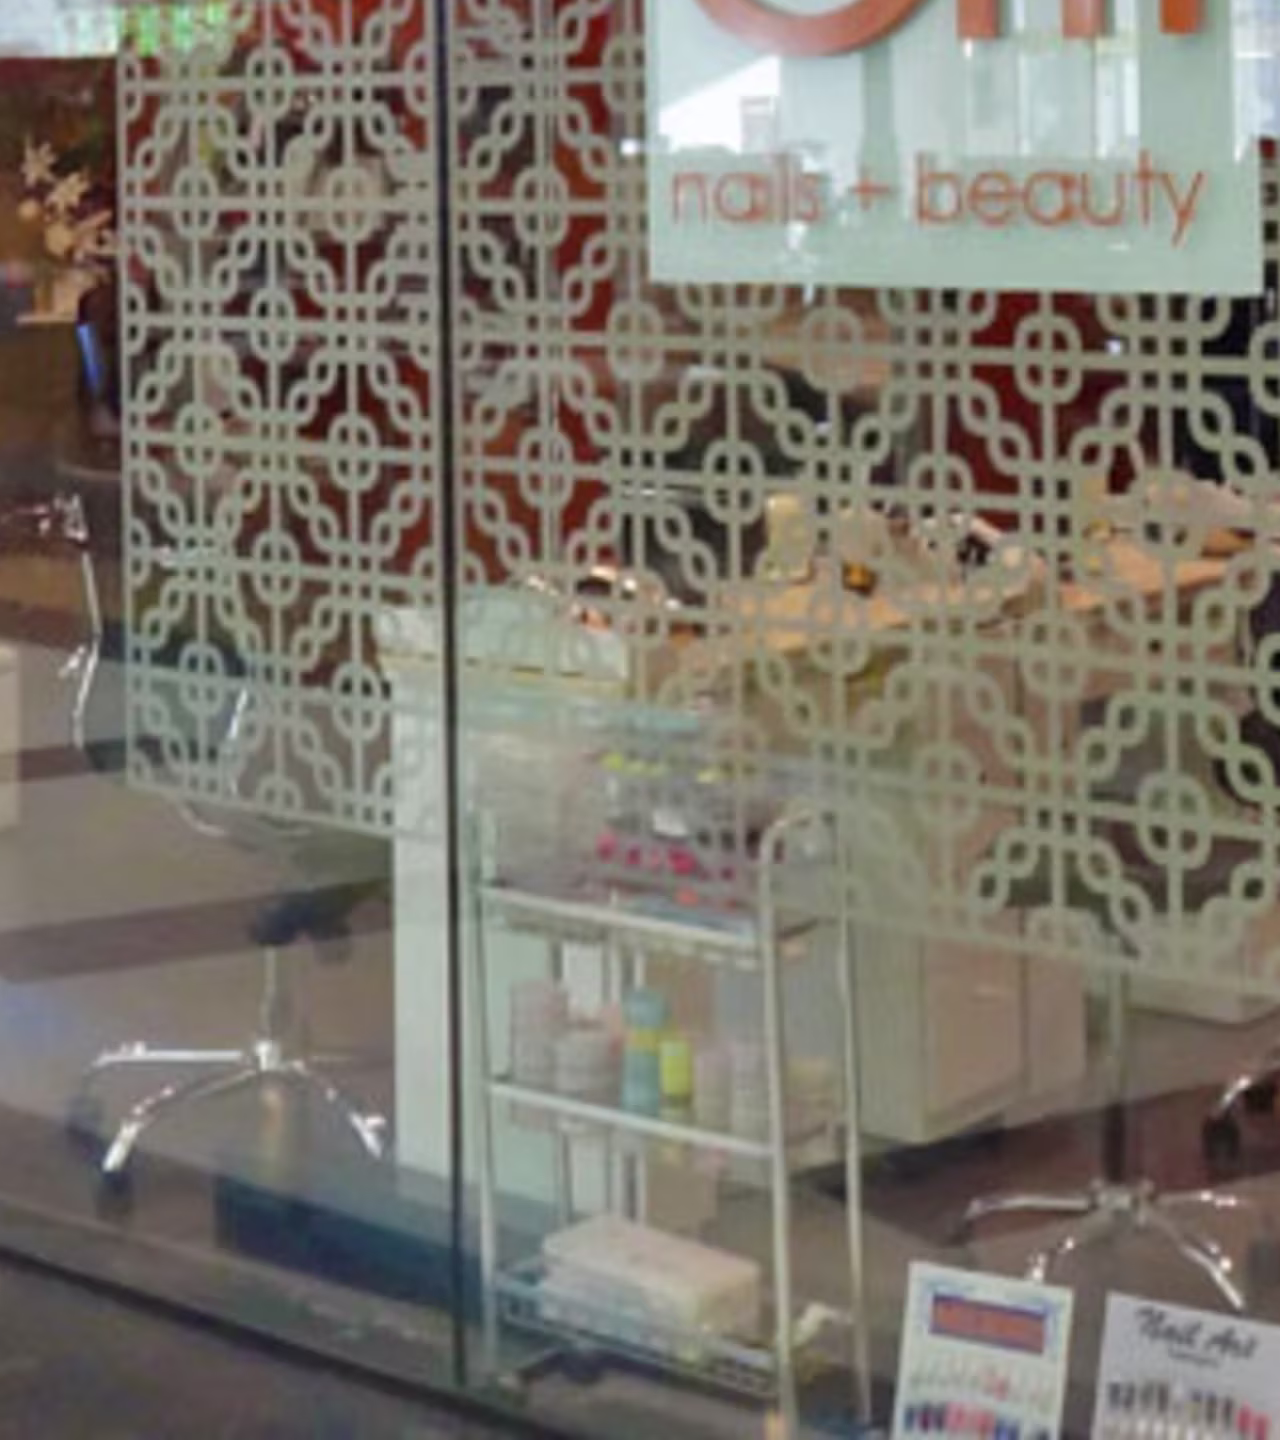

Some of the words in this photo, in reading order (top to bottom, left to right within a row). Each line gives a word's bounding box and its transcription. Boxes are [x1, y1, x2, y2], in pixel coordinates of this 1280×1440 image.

[671, 152, 825, 224] nails
[848, 172, 894, 212] +
[913, 148, 1207, 248] beauty
[1135, 1305, 1203, 1348] Nail
[1205, 1325, 1260, 1359] Art
